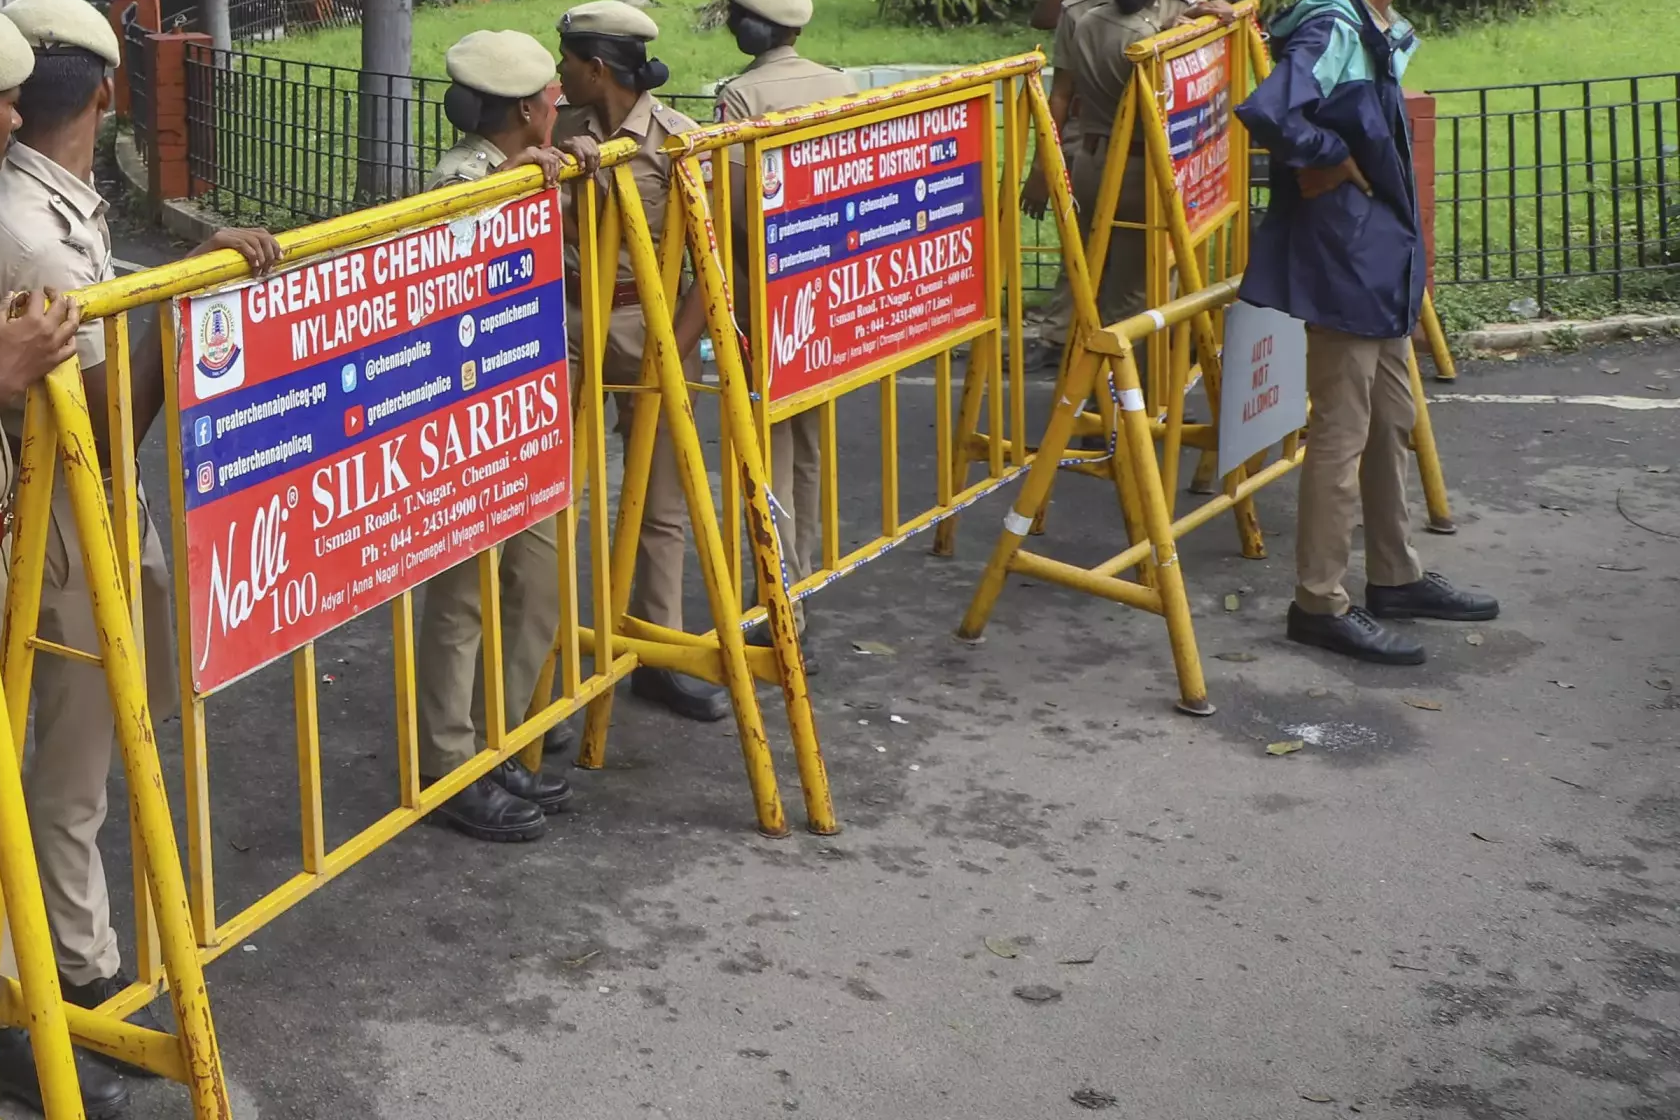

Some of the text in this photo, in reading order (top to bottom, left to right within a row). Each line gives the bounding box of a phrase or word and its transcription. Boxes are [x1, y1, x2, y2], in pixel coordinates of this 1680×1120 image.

[790, 129, 857, 168] GREATER
[860, 114, 920, 152] CHENNAI
[923, 104, 968, 137] POLICE
[813, 156, 874, 197] MYLAPORE
[879, 143, 928, 179] DISTRICT
[247, 253, 366, 323] GREATER
[479, 199, 552, 253] POLICE
[827, 226, 974, 311] SILK SAREES
[291, 291, 398, 362] MYLAPORE
[406, 264, 485, 324] DISTRICT
[488, 263, 513, 289] MYL
[520, 253, 534, 279] 30
[365, 340, 432, 380] @chennaipolice
[481, 340, 541, 374] kavalansosapp
[803, 336, 832, 374] 100
[1251, 335, 1273, 364] AUTO
[216, 381, 328, 439] greaterchennaipoliceg-gcp
[367, 374, 452, 426] greaterchennaipolice
[219, 433, 313, 486] greaterchennaipoliceg
[311, 372, 560, 531] SILK SAREES
[314, 524, 361, 557] Usman
[364, 506, 402, 535] Road,
[404, 481, 457, 517] T.Nagar,
[462, 451, 510, 487] Chennai
[520, 440, 539, 461] 600
[541, 429, 563, 453] 017.
[361, 544, 379, 567] Ph
[390, 528, 412, 552] 044
[422, 497, 476, 541] 24314900
[478, 487, 491, 511] (7
[493, 473, 529, 501] Lines)
[320, 477, 566, 613] Adyar Anna Nagar Chromepet Mylapore Velachery Vadapalani
[269, 572, 318, 635] 100
